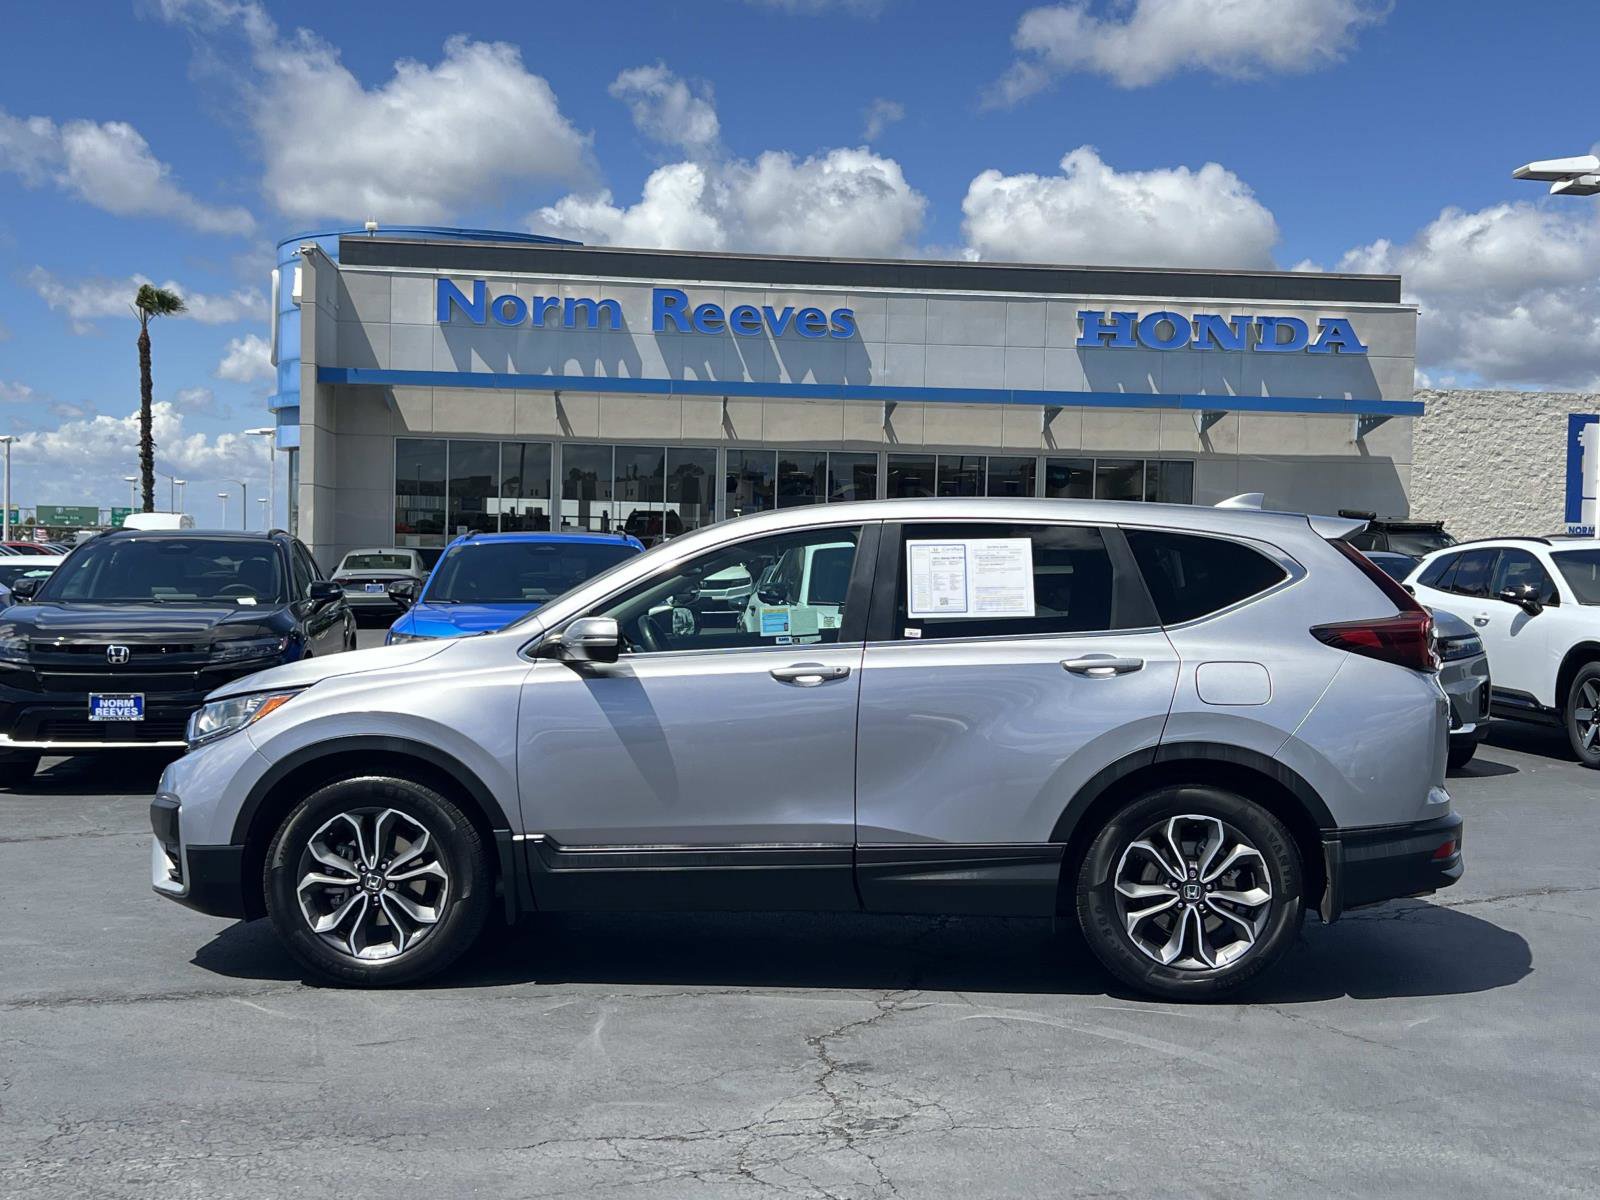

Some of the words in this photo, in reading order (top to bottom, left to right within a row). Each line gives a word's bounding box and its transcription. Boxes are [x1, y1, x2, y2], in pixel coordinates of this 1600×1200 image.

[437, 279, 623, 330] Norm
[652, 288, 855, 338] Reeves
[1076, 310, 1368, 353] HONDA
[1568, 526, 1595, 534] NORM
[99, 699, 134, 707] NORM
[95, 708, 139, 716] REEVES
